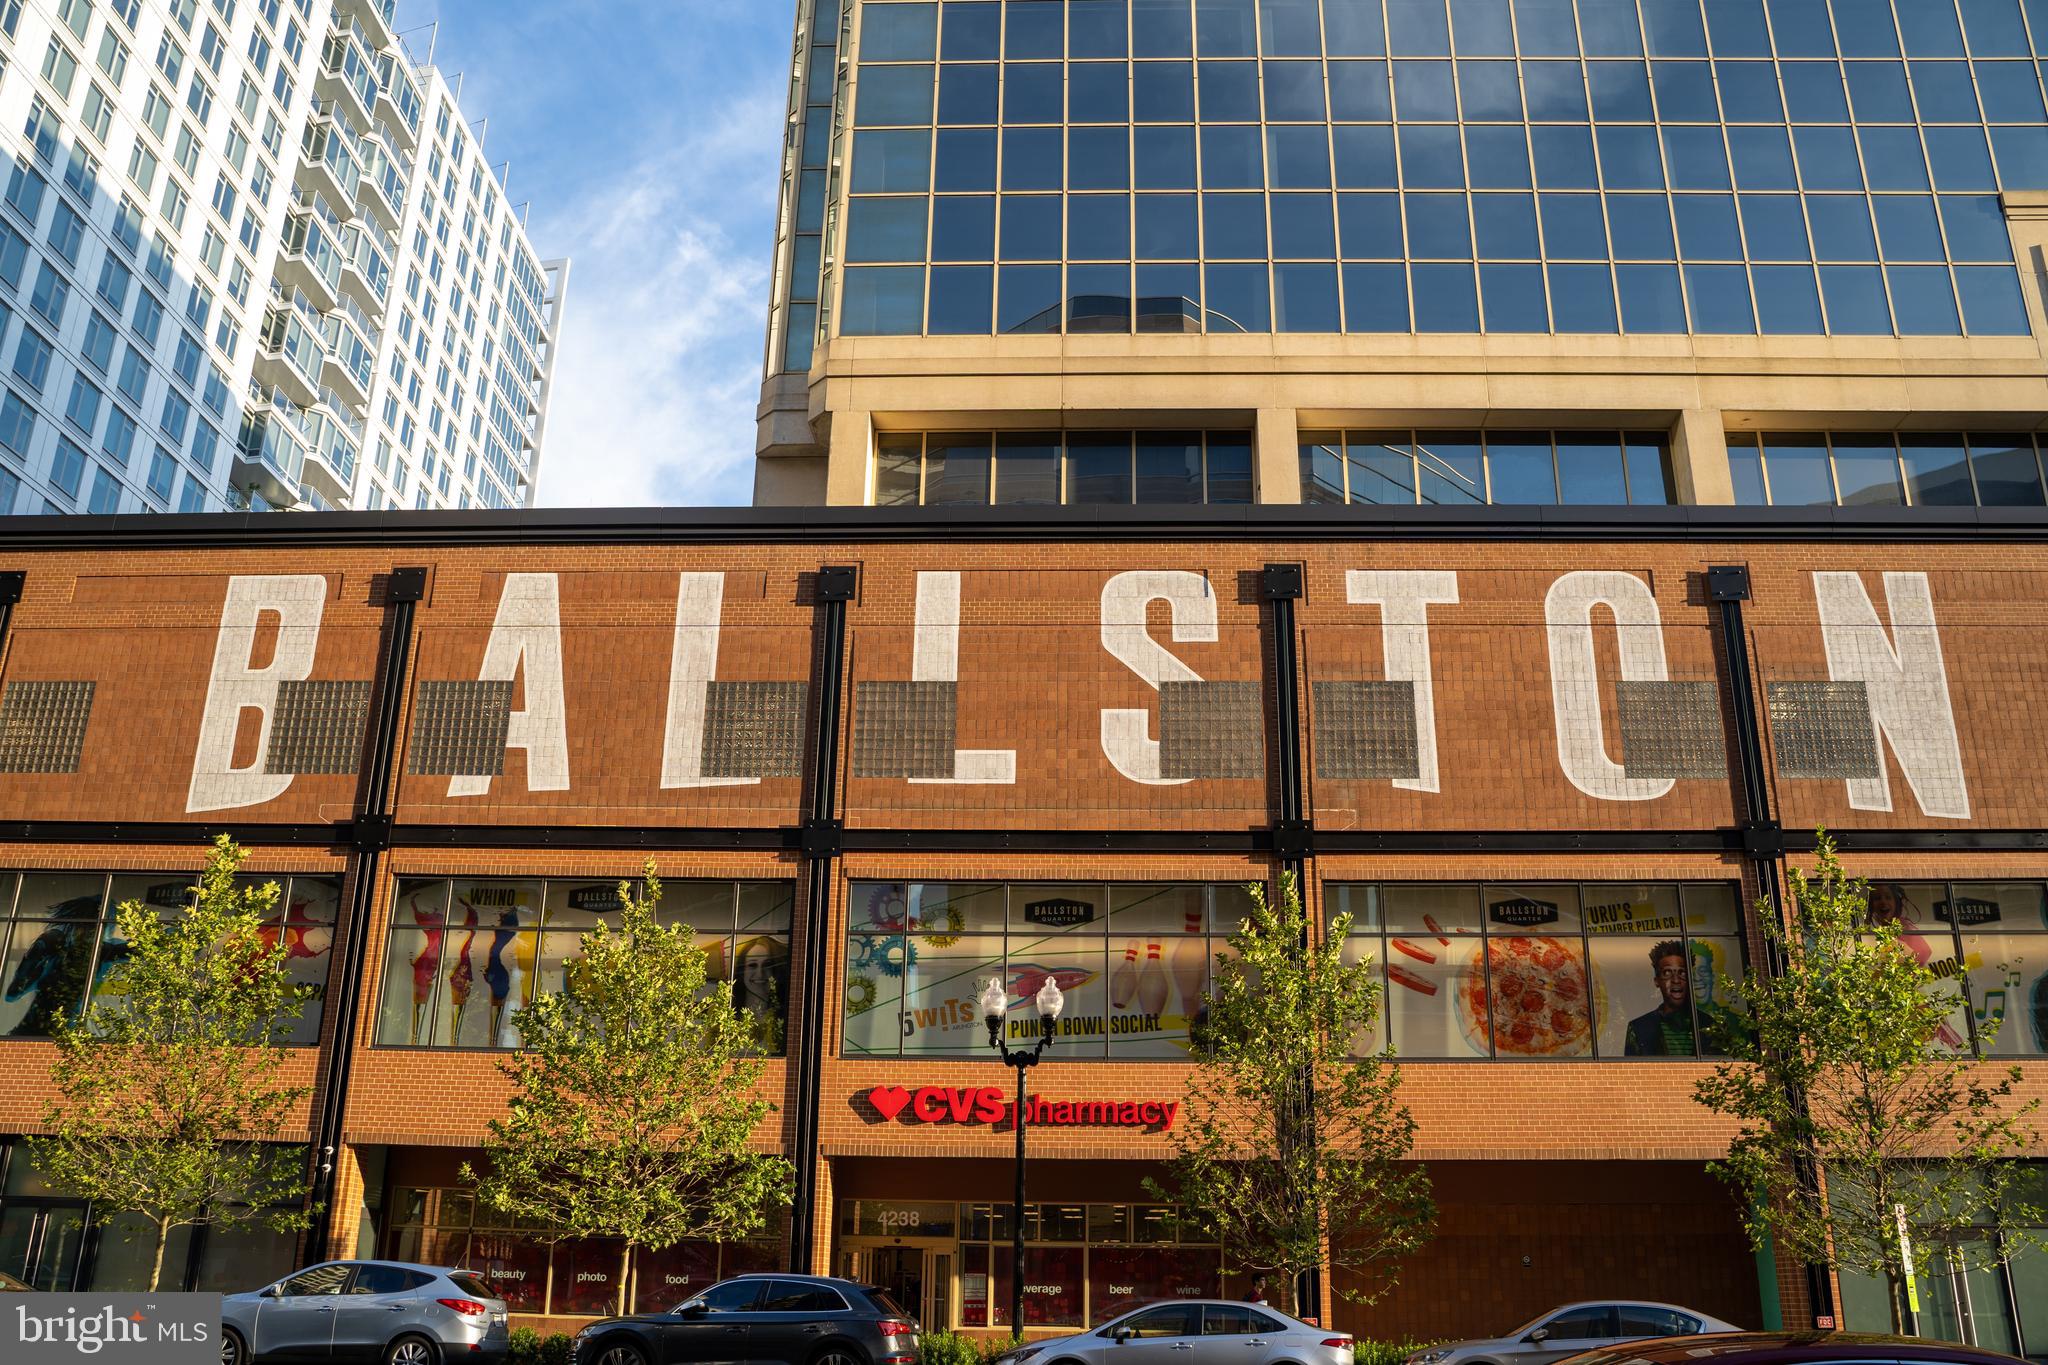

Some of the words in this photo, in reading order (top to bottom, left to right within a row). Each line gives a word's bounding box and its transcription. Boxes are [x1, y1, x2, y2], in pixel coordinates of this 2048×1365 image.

[186, 569, 1971, 819] BALLSTON
[470, 888, 516, 906] WHINO
[577, 892, 619, 902] BALLSTO
[1034, 906, 1084, 916] BALLSTON
[1499, 906, 1549, 916] BALLSTON
[1586, 903, 1633, 925] URU'S
[1941, 904, 1991, 915] BLLSTON
[1636, 918, 1662, 932] PIZZA
[1063, 1016, 1105, 1036] BOWL
[1111, 1012, 1162, 1034] SOCIAL
[914, 1086, 1005, 1123] CVS
[1012, 1093, 1180, 1131] pharmacy
[878, 1210, 920, 1228] 4238
[491, 1269, 526, 1281] beauty
[577, 1271, 607, 1283] photo
[665, 1274, 689, 1285] food
[1022, 1284, 1062, 1296] verage
[1109, 1283, 1134, 1295] beer
[1176, 1285, 1201, 1295] wine
